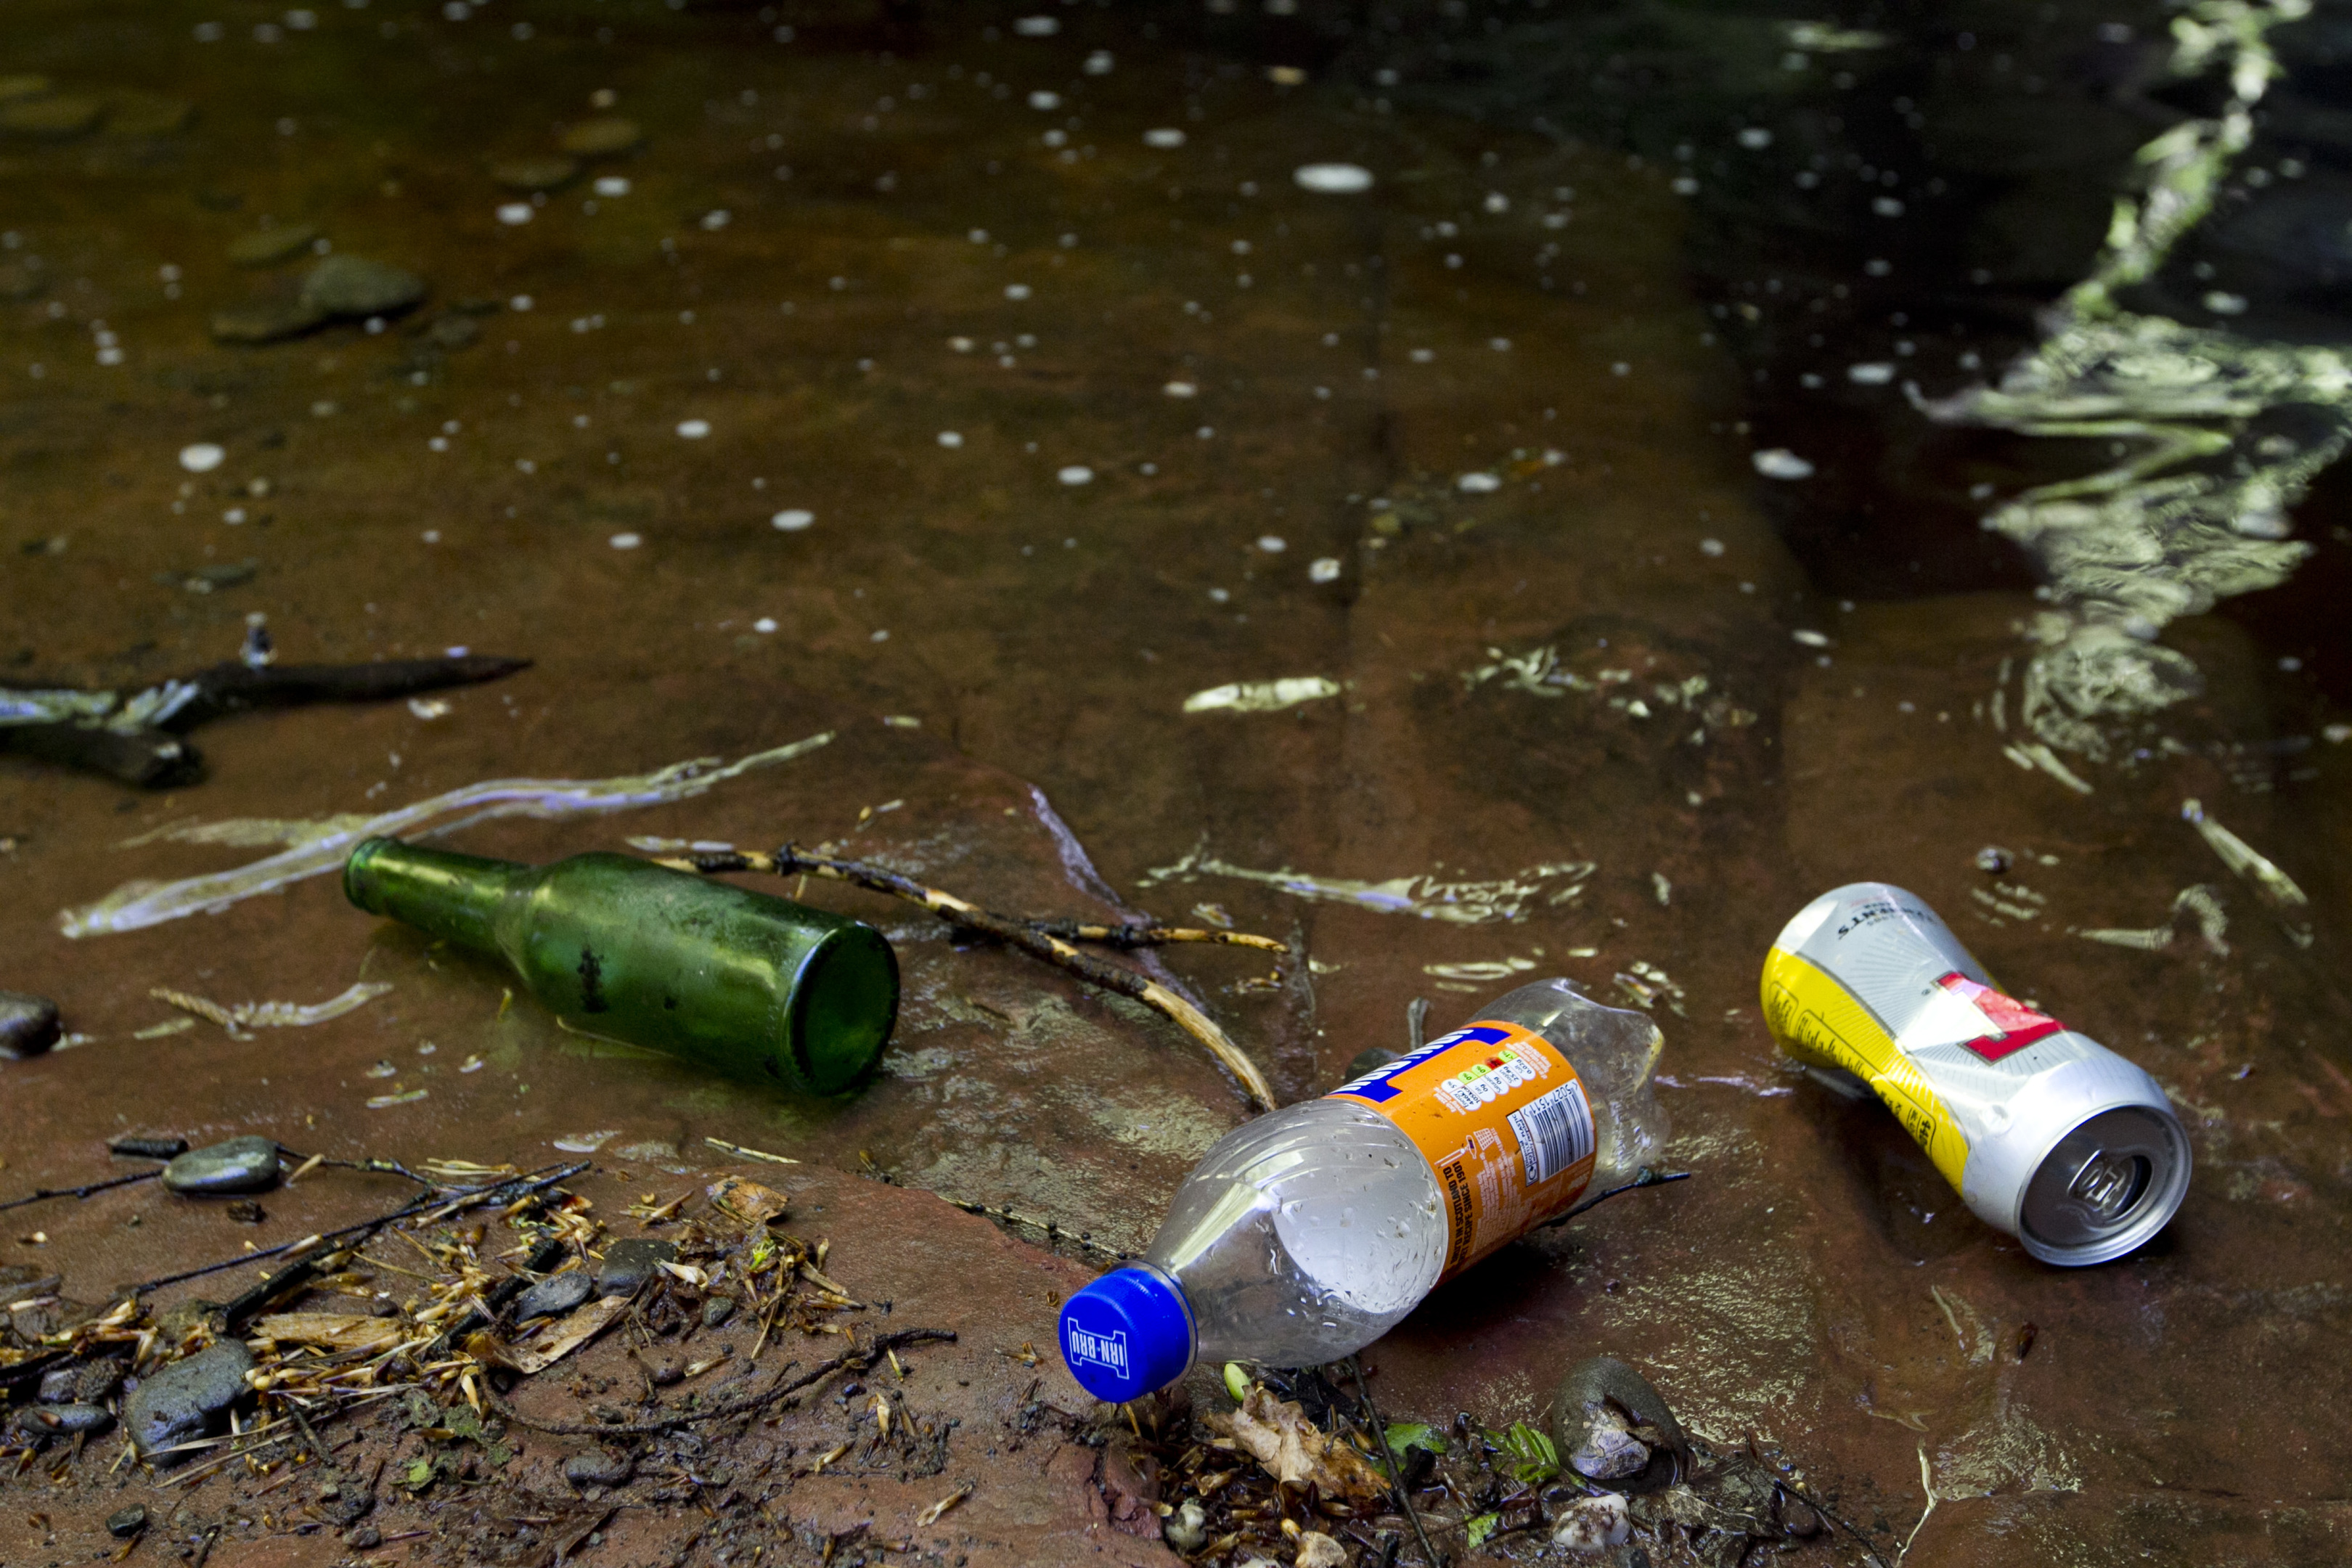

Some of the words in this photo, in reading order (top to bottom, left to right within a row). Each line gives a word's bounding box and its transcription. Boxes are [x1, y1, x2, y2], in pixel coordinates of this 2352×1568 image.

[1515, 1058, 1532, 1074] 0.02g
[1492, 1075, 1502, 1085] 0g
[1498, 1068, 1514, 1084] Sugars
[1461, 1085, 1481, 1103] 105kcal
[1479, 1083, 1488, 1093] 0g
[1551, 1083, 1572, 1102] 5027
[1452, 1092, 1469, 1108] Energy
[1457, 1089, 1474, 1106] 446kJ
[1529, 1096, 1550, 1114] 1511
[1511, 1114, 1525, 1138] PLASTIC
[1519, 1119, 1531, 1142] recycled
[1442, 1166, 1453, 1180] TO
[1451, 1160, 1466, 1183] 1901
[1447, 1179, 1465, 1226] SCOTLAND
[1459, 1182, 1471, 1212] SINCE
[1455, 1225, 1463, 1238] IN
[1463, 1212, 1472, 1245] RECIPE
[1071, 1331, 1124, 1367] IRN-BRU
